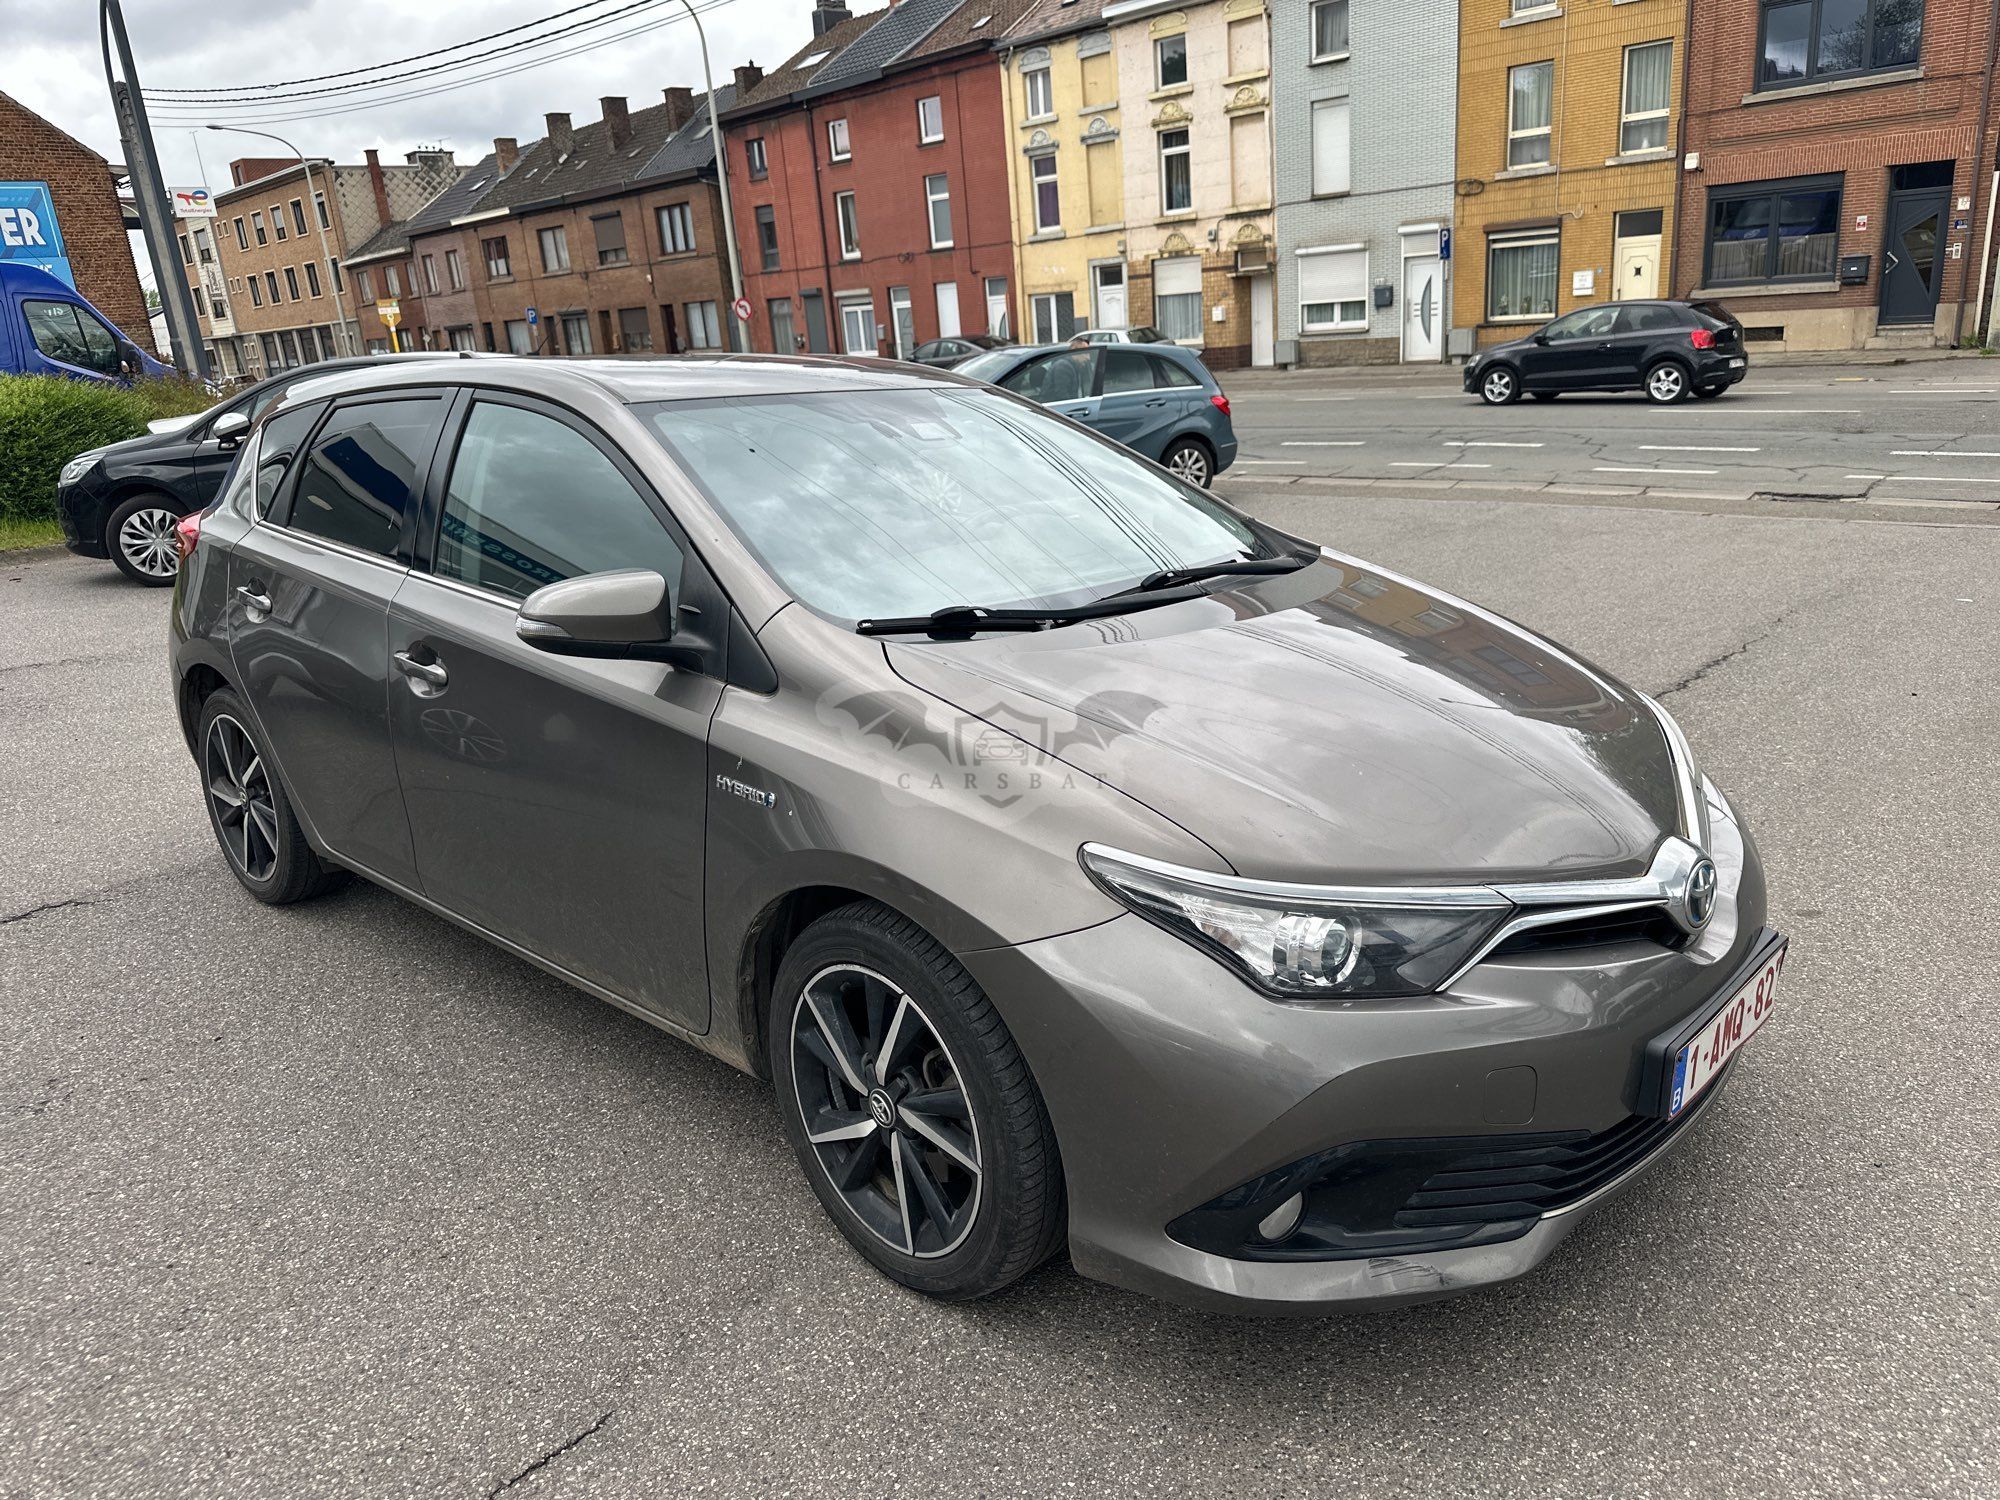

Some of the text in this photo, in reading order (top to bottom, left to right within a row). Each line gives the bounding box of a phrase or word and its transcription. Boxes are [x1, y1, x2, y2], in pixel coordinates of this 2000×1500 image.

[1441, 230, 1449, 248] P
[528, 309, 536, 322] P
[716, 774, 766, 804] HYBRID
[1672, 1088, 1681, 1110] B
